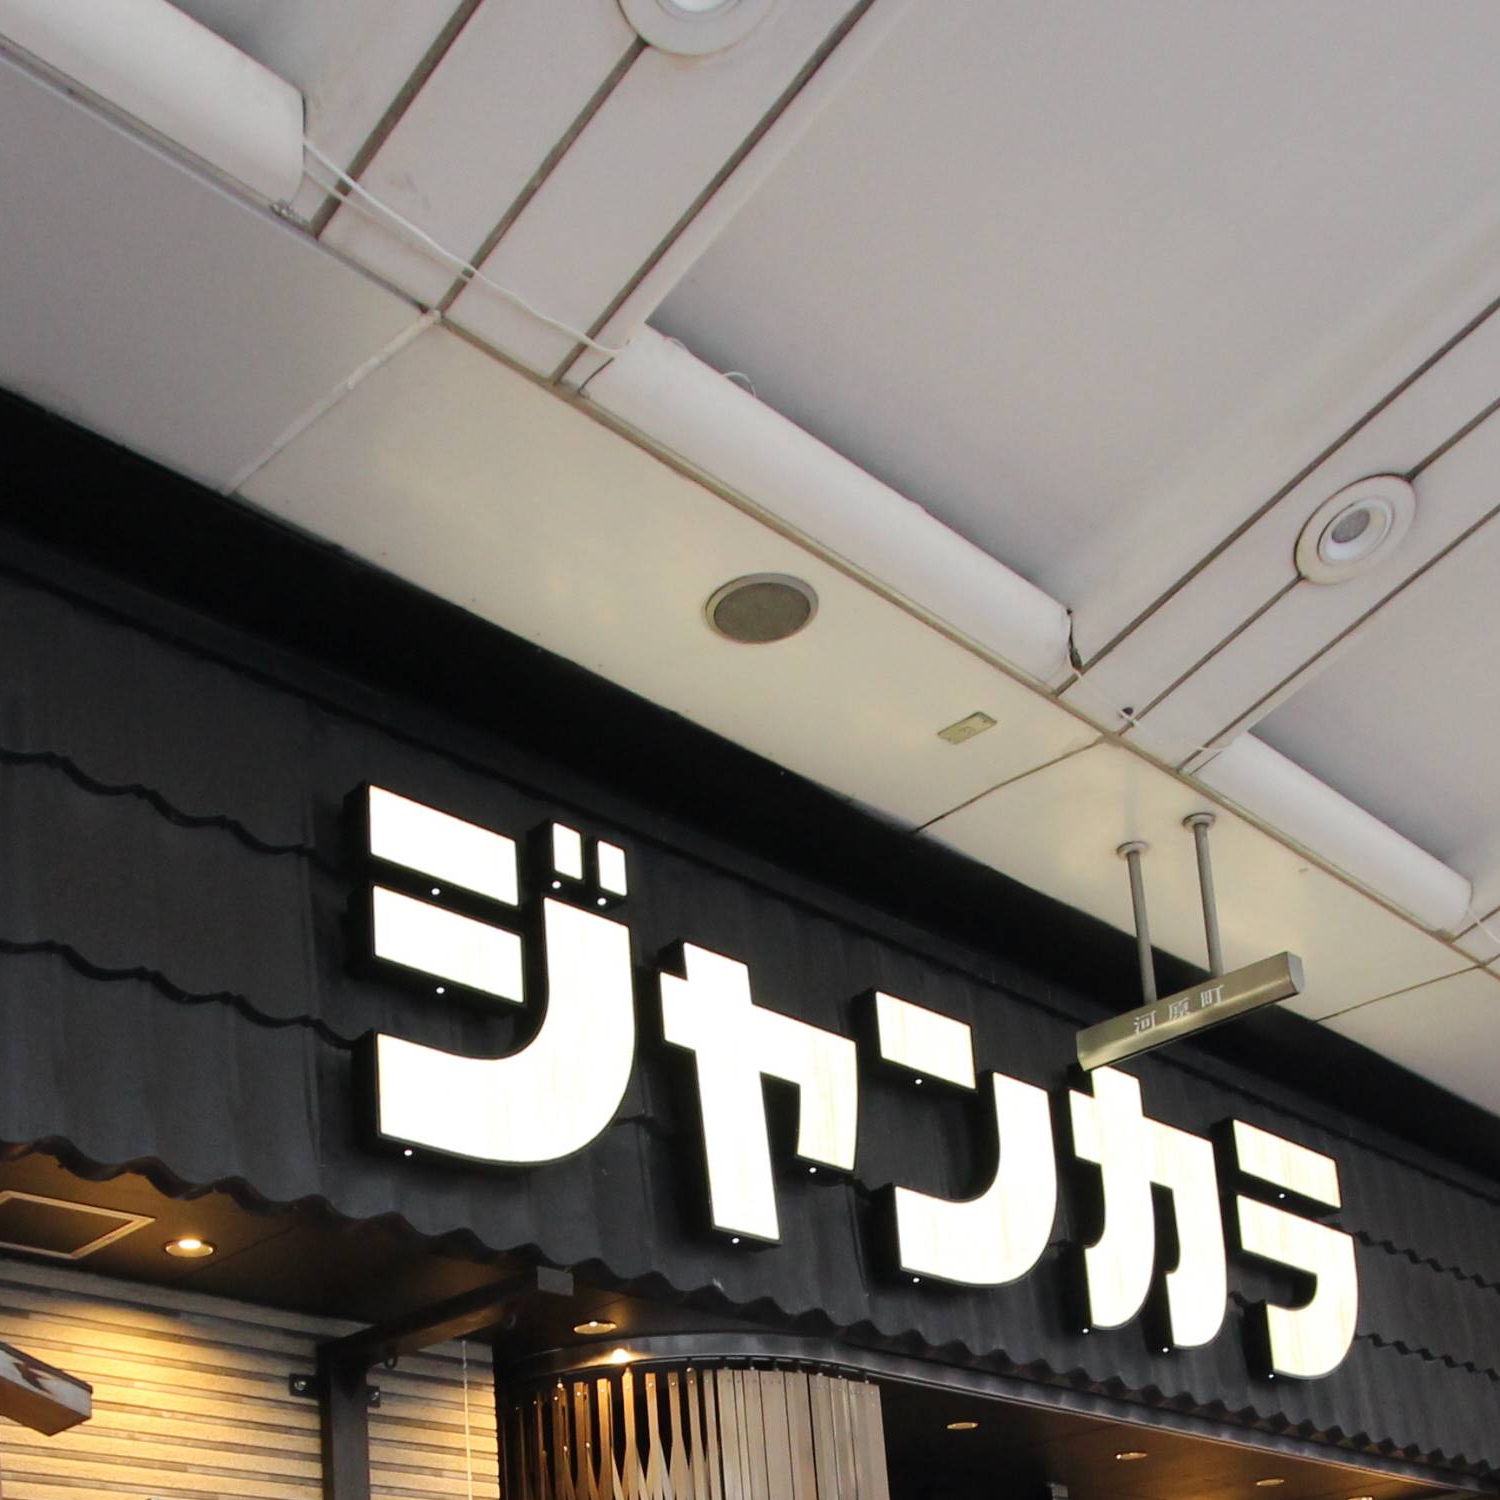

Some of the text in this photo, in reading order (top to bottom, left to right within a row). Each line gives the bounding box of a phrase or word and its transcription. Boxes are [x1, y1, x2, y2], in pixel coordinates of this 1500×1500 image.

[368, 784, 1358, 1380] ジャンカラ
[1134, 984, 1224, 1034] 河原町
